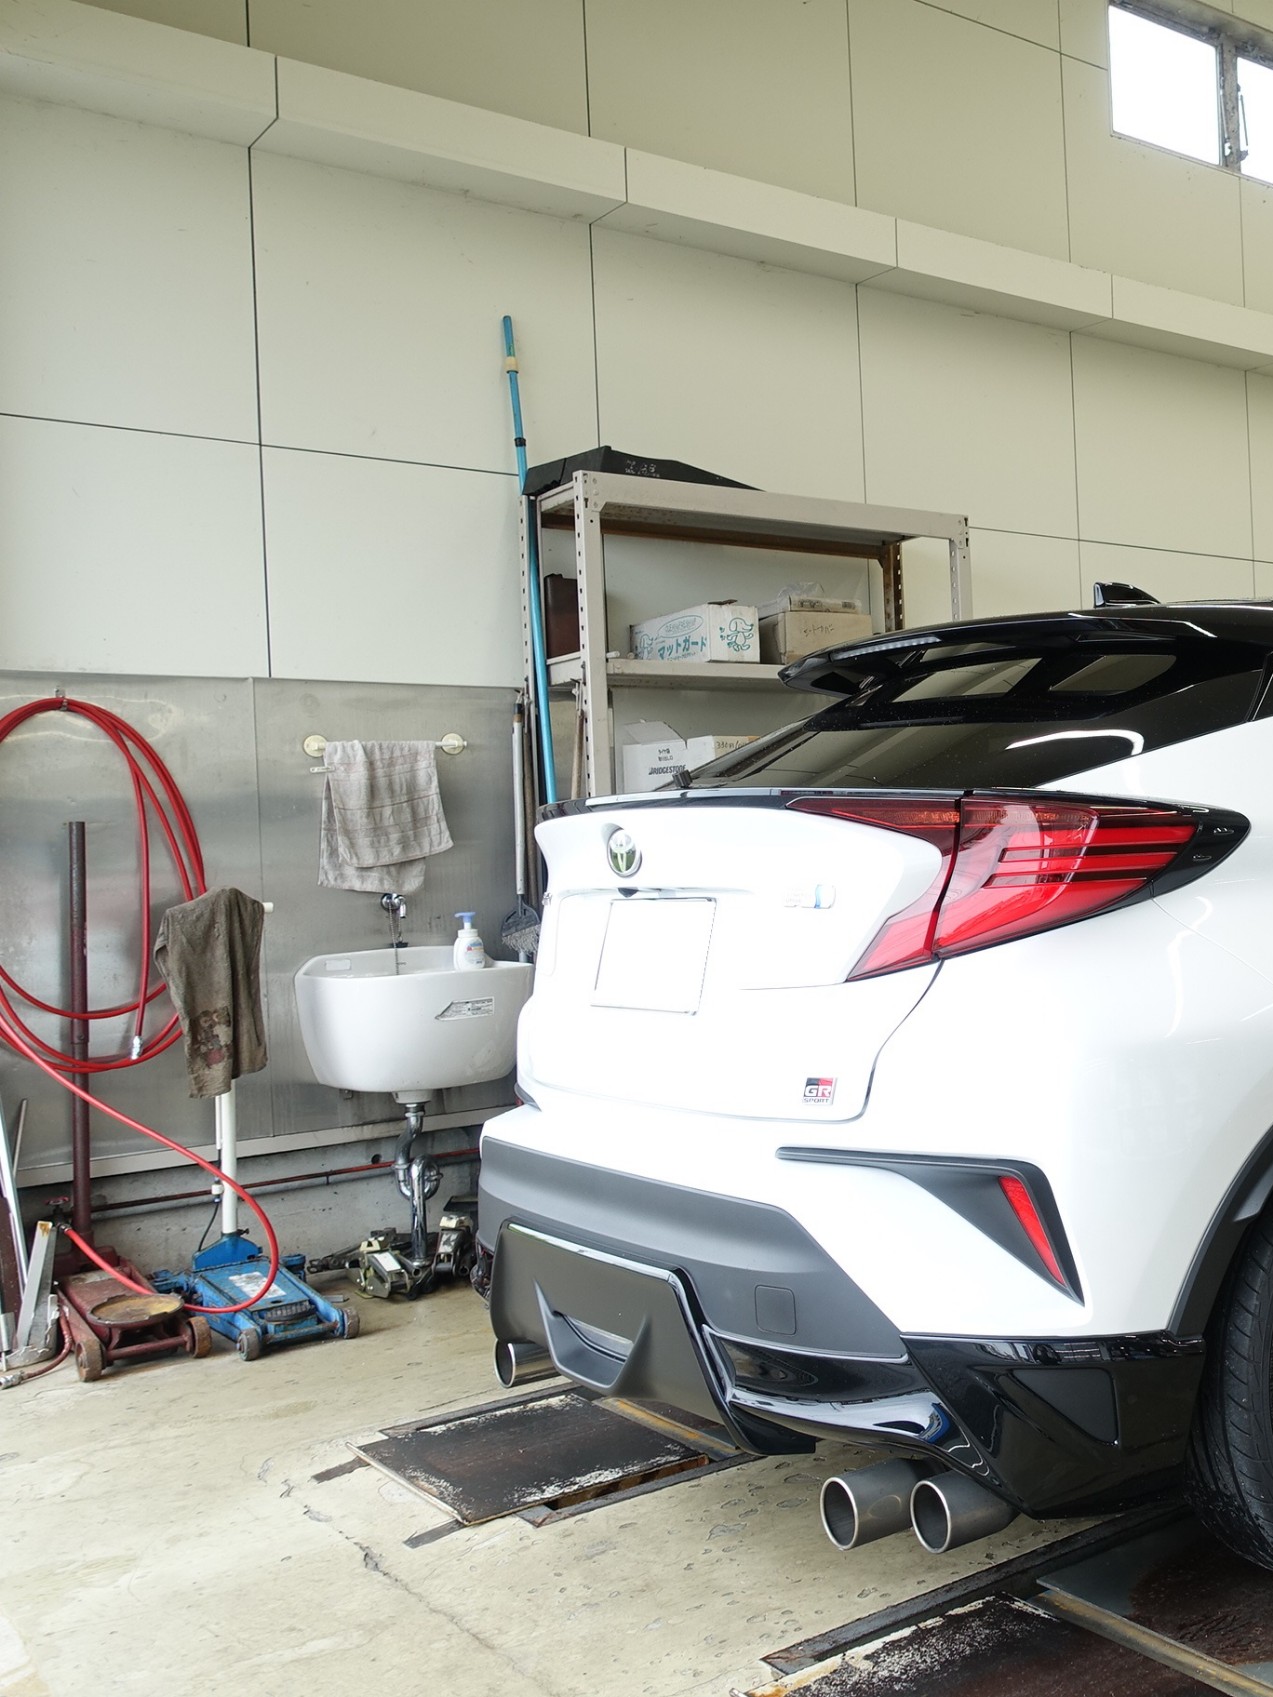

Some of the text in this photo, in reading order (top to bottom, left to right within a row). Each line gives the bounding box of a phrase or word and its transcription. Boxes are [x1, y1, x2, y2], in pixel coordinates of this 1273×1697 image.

[658, 636, 707, 660] マットガード
[804, 1085, 832, 1097] GR
